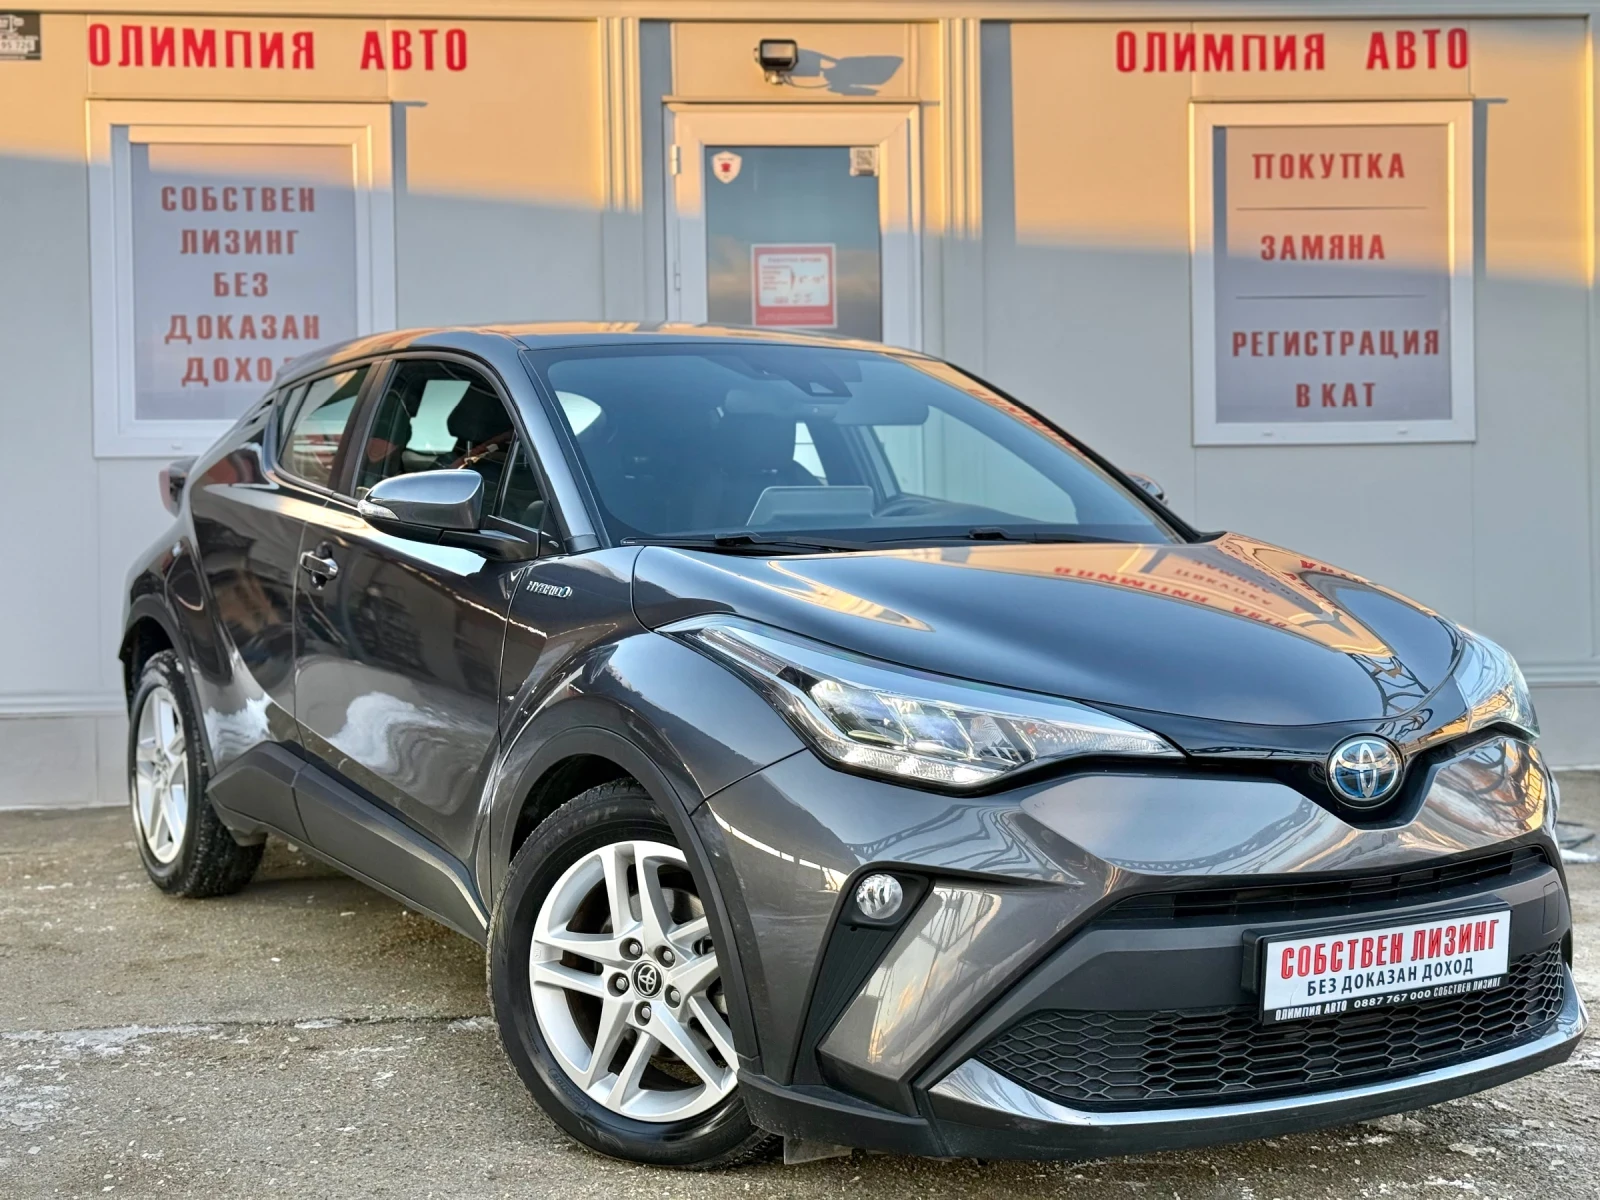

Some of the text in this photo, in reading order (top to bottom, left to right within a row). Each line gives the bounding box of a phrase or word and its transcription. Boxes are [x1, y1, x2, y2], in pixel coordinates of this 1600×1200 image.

[88, 23, 468, 72] ОЛИМПИЯ АВТО
[1115, 28, 1469, 73] ОЛИМПИЯ АВТО
[1252, 153, 1405, 179] ПОКУПКА
[161, 186, 314, 212] СОБСТВЕН
[180, 229, 299, 255] ЛИЗИНГ
[1261, 234, 1385, 260] ЗАМЯНА
[213, 273, 268, 297] БЕЗ
[165, 315, 320, 344] ДОКАЗАН
[1233, 330, 1439, 358] РЕГИСТРАЦИЯ
[181, 357, 294, 387] ДОХО
[1296, 382, 1376, 407] В КАТ
[1281, 919, 1500, 979] СОБСТВЕН ЛИЗИНГ
[1307, 957, 1474, 996] БЕЗ ДОКАЗАН ДОХОД
[1275, 976, 1502, 1021] ОЛИМПИЯ АВТО 0887 767 000 СОБСТВЕН ЛИЗИНГ
